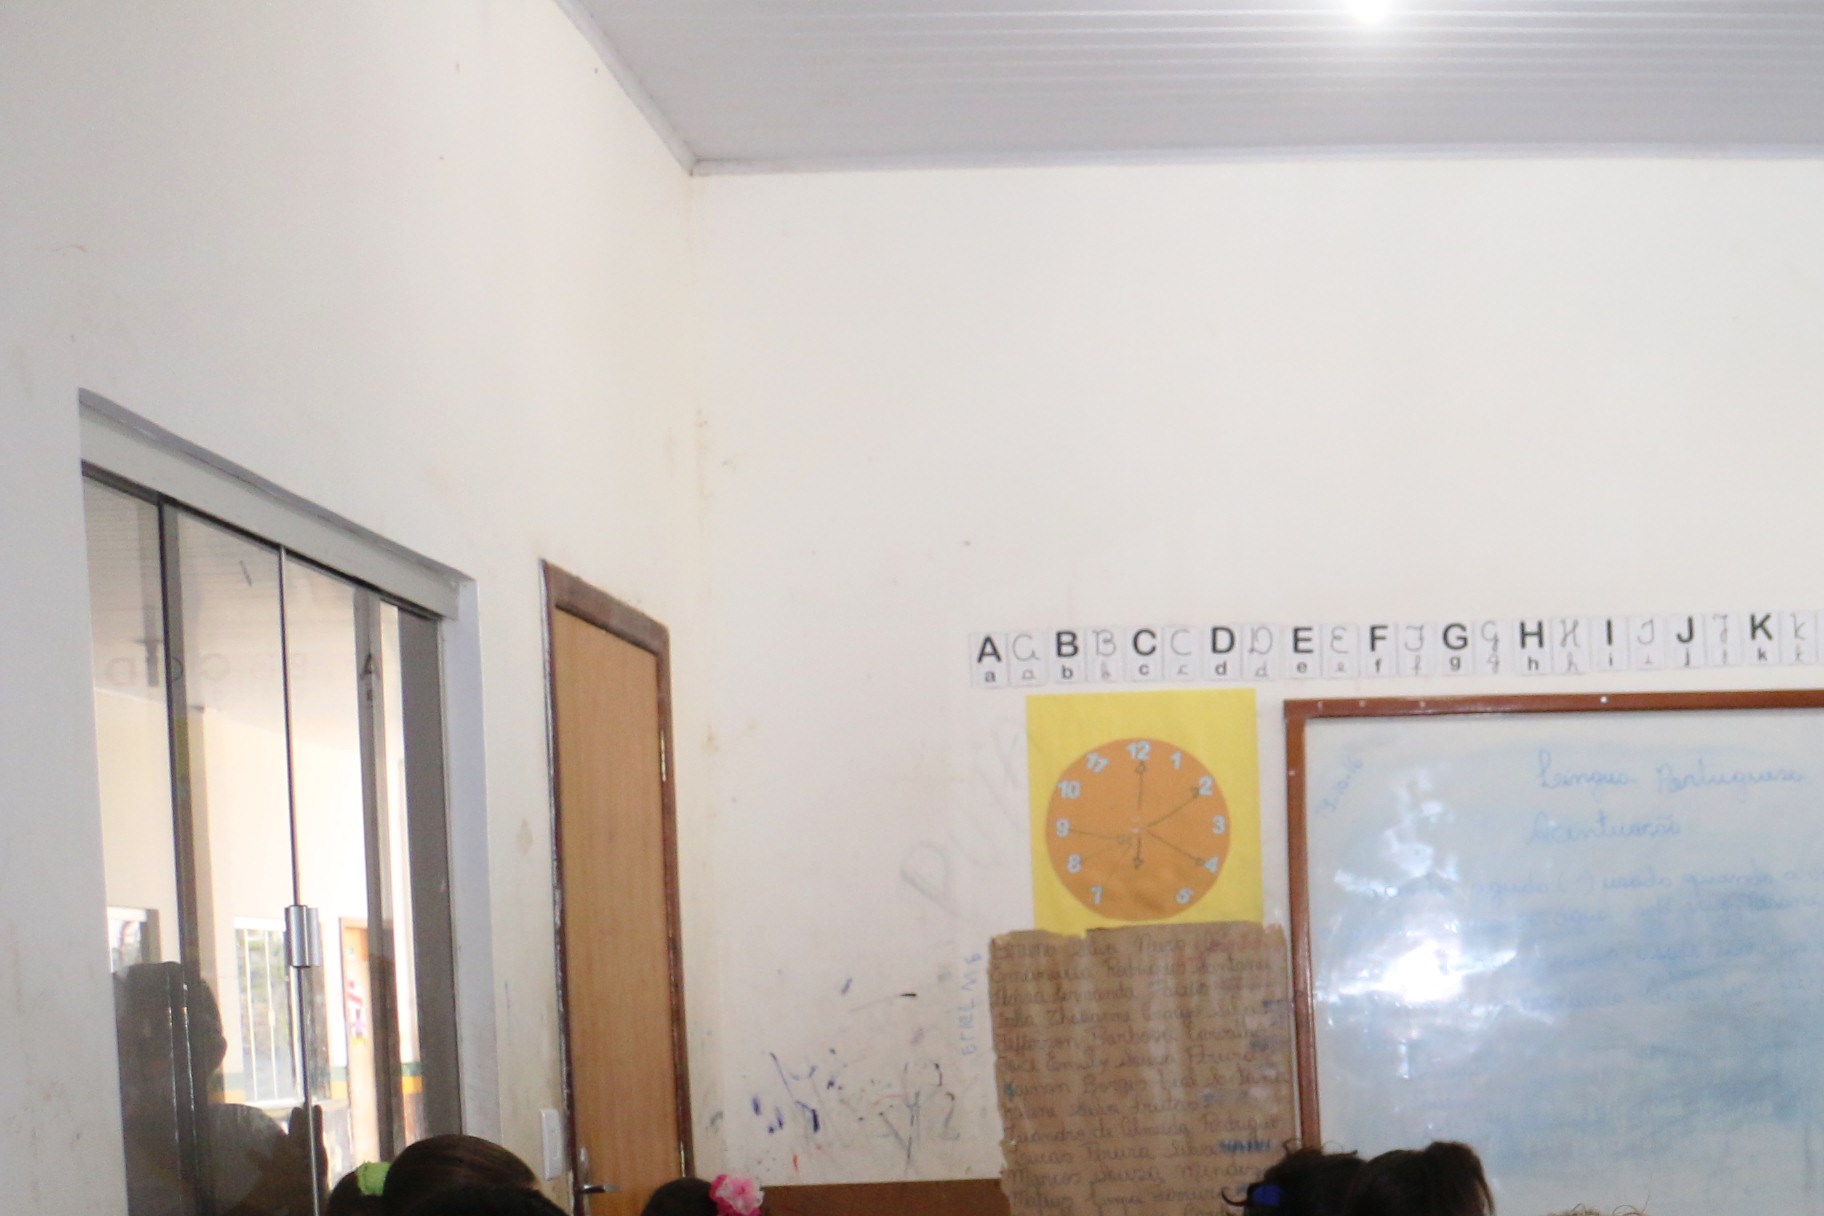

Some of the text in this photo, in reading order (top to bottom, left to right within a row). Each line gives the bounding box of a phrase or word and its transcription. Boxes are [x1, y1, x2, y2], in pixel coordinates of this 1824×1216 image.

[978, 636, 1001, 663] A
[1056, 631, 1078, 657] B
[1133, 629, 1156, 656] C
[1212, 627, 1235, 653] D
[1293, 627, 1312, 653] E
[1370, 626, 1387, 651] F
[1443, 624, 1467, 650] G
[1520, 622, 1543, 648] H
[1605, 618, 1613, 647] I
[1677, 617, 1693, 643] J
[1751, 615, 1772, 639] K
[984, 666, 996, 684] a
[1062, 666, 1073, 679] b
[1139, 664, 1149, 675] c
[1215, 662, 1227, 675] d
[1295, 661, 1308, 675] e
[1450, 657, 1461, 670] g
[1528, 657, 1539, 670] h
[1127, 740, 1151, 760] 12
[1170, 751, 1183, 770] 1
[1056, 780, 1081, 798] 10
[1199, 775, 1214, 796] 2
[1056, 817, 1070, 837] 9
[1212, 814, 1226, 835] 3
[1067, 853, 1082, 873] 8
[1204, 856, 1219, 874] 4
